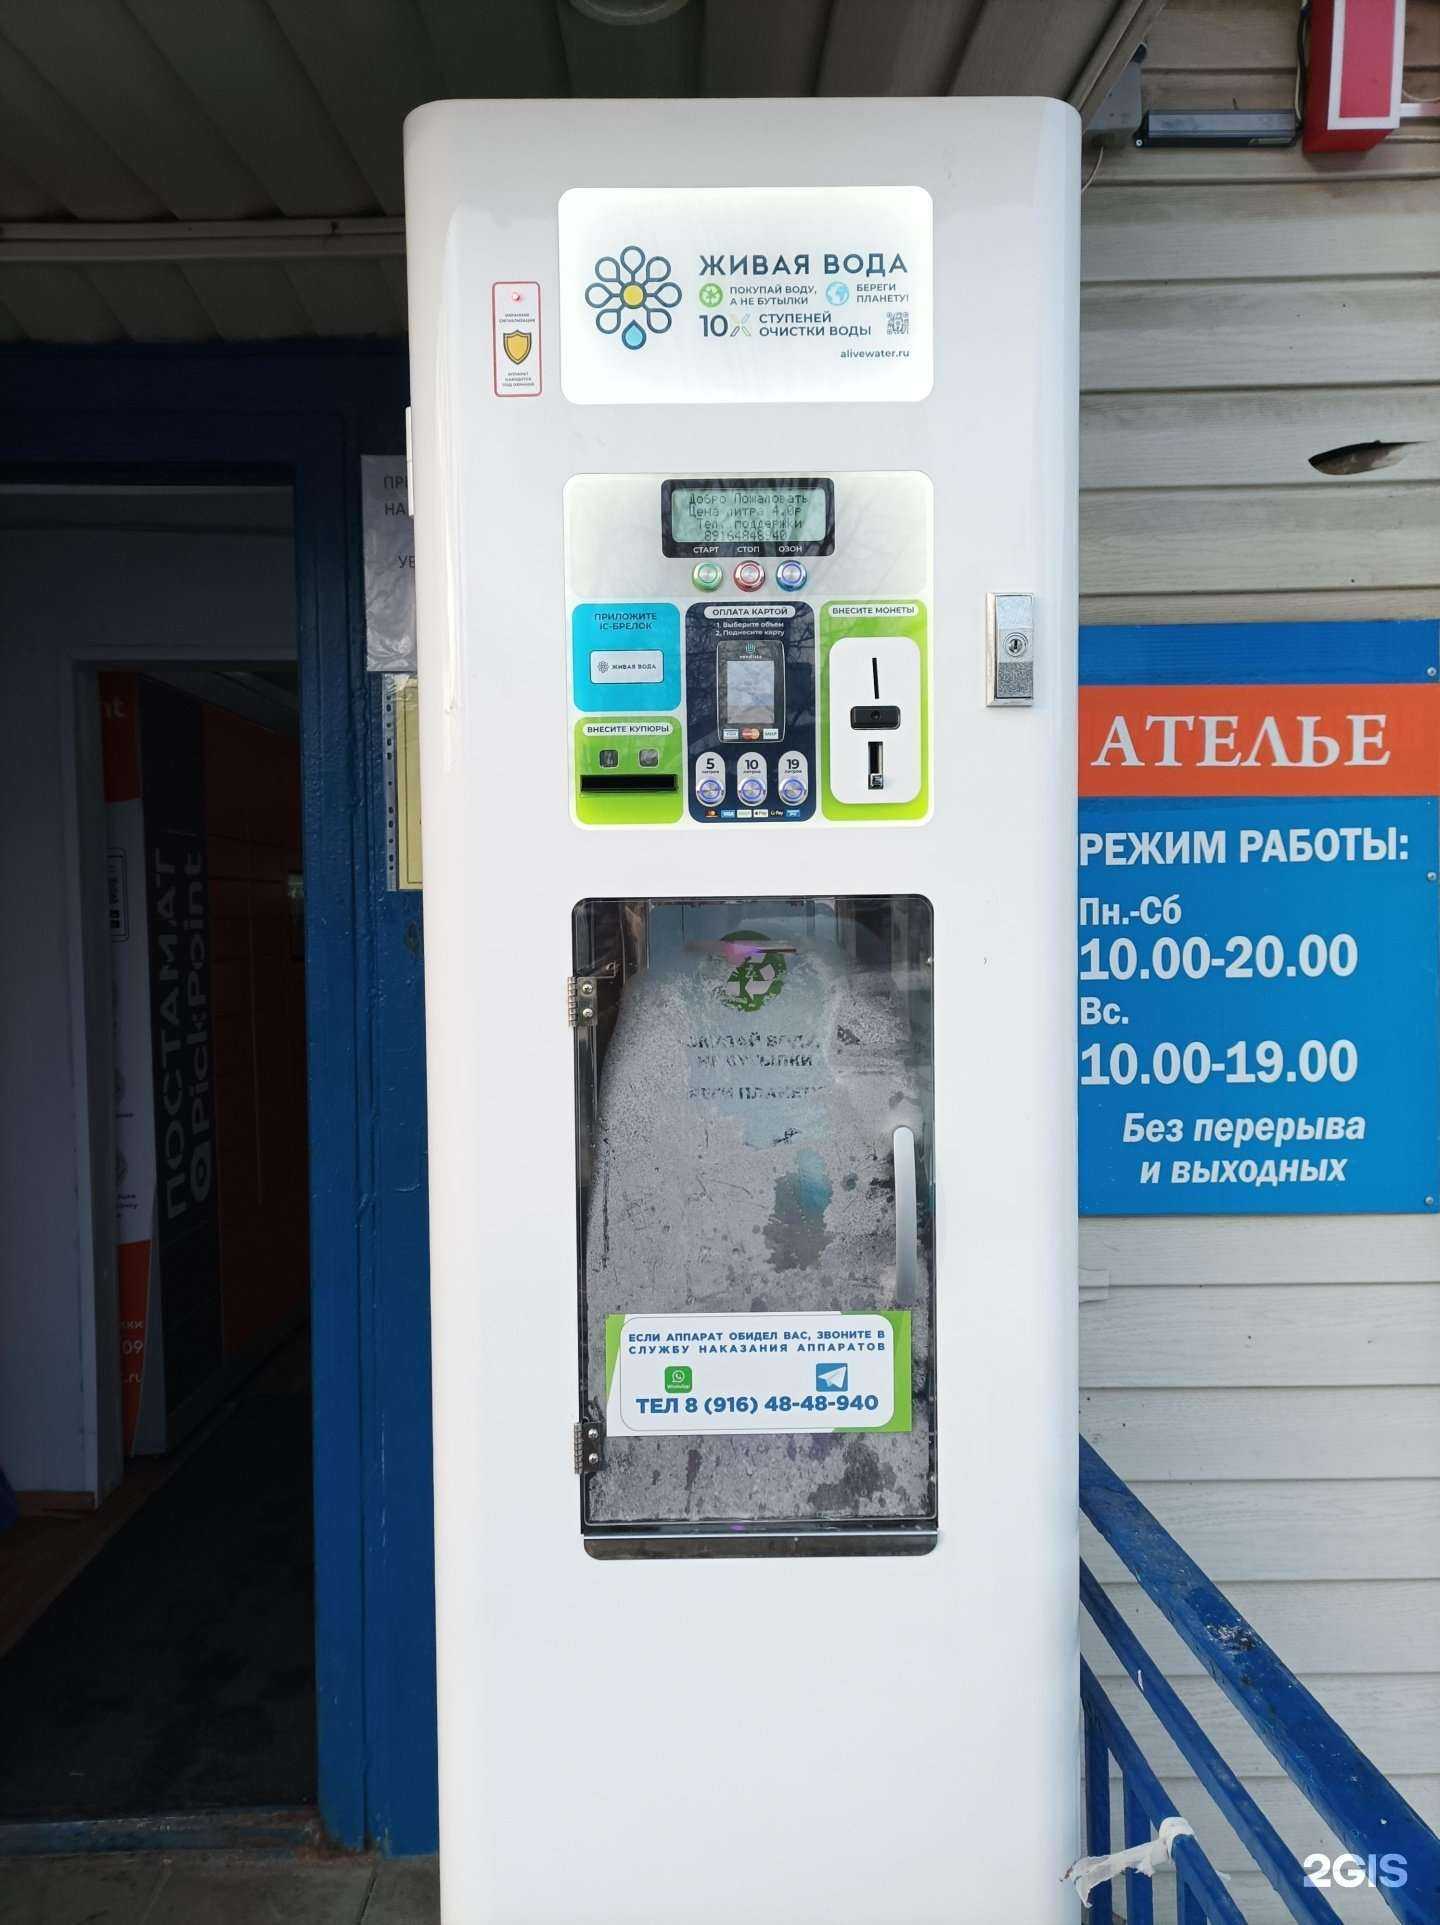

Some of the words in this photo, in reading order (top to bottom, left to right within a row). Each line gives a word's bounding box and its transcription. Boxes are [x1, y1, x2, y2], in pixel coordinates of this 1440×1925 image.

[699, 254, 810, 276] ЖИВАЯ
[823, 253, 909, 277] ВОДА
[729, 285, 782, 295] ПОКУПАЙ
[785, 285, 817, 295] ВОДУ,
[856, 283, 896, 292] БЕРЕГИ
[729, 297, 738, 306] А
[740, 297, 755, 305] НЕ
[757, 296, 809, 305] БУТЫЛКИ
[856, 294, 909, 303] ПЛАНЕТУ!
[759, 311, 832, 323] СТУПЕНЕЙ
[759, 326, 825, 337] ОЧИСТКИ
[829, 325, 872, 337] ВОДЫ
[840, 349, 910, 358] alivewater.ru
[688, 493, 727, 504] Добро
[688, 506, 720, 517] Цена
[778, 545, 803, 553] ОЗОН
[712, 608, 750, 616] ОПЛАТА
[752, 607, 788, 615] КАРТОЙ
[832, 606, 872, 615] ВНЕСИТЕ
[873, 605, 915, 614] МОНЕТЫ
[594, 612, 657, 621] ПРИЛОЖИТЕ
[722, 621, 760, 629] Выберите
[722, 629, 762, 637] Поднесите
[629, 725, 669, 733] КУПЮРЫ
[1090, 714, 1391, 768] АТЕЛЬЕ
[706, 758, 715, 769] 5
[745, 759, 759, 770] 10
[786, 759, 800, 769] 19
[1079, 830, 1226, 866] РЕЖИМ
[1239, 827, 1409, 865] РАБОТЫ:
[1079, 895, 1182, 926] Пн.-Сб
[1079, 933, 1358, 981] 10.00-20.00
[1079, 996, 1129, 1026] Вс.
[154, 847, 188, 1222] ПОСТАМАТ
[1079, 1039, 1358, 1086] 10.00-19.00
[1122, 1112, 1184, 1144] Без
[1193, 1113, 1367, 1148] перерыва
[1139, 1160, 1161, 1184] и
[1170, 1157, 1348, 1187] выходных
[629, 1333, 660, 1342] ЕСЛИ
[666, 1332, 723, 1341] АППАРАТ
[729, 1331, 778, 1341] ОБИДЕЛ
[783, 1331, 811, 1341] ВАС,
[817, 1330, 872, 1340] ЗВОНИТЕ
[877, 1330, 885, 1339] В
[629, 1345, 690, 1354] СЛУЖБУ
[699, 1344, 788, 1353] НАКАЗАНИЯ
[797, 1342, 885, 1352] АППАРАТОВ
[636, 1397, 679, 1414] ТЕЛ
[685, 1397, 698, 1413] 8
[704, 1396, 758, 1415] (916)
[764, 1394, 879, 1412] 48-48-940
